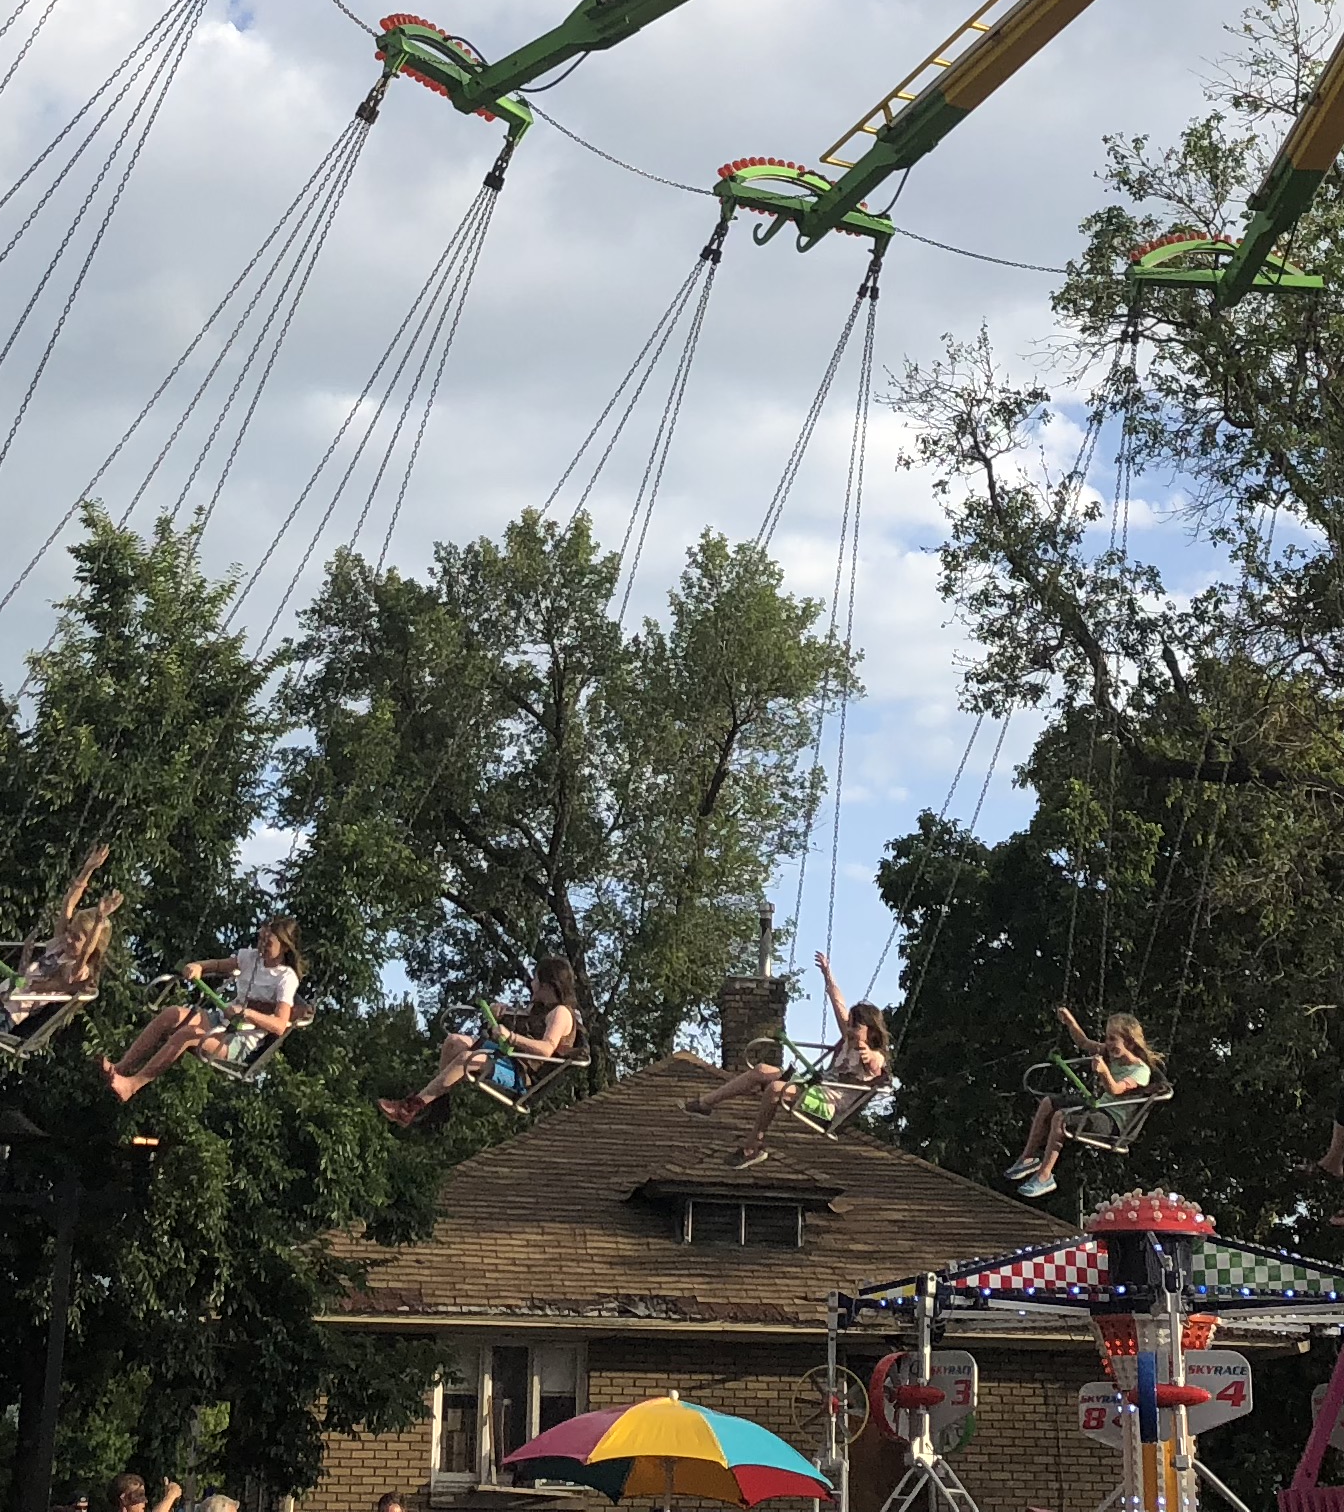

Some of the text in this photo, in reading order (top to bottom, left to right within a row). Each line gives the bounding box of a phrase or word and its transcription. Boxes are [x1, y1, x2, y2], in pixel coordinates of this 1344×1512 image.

[1187, 1364, 1249, 1376] SKYRACE
[951, 1379, 972, 1406] 3
[1215, 1380, 1248, 1407] 4
[1082, 1407, 1107, 1429] 8
